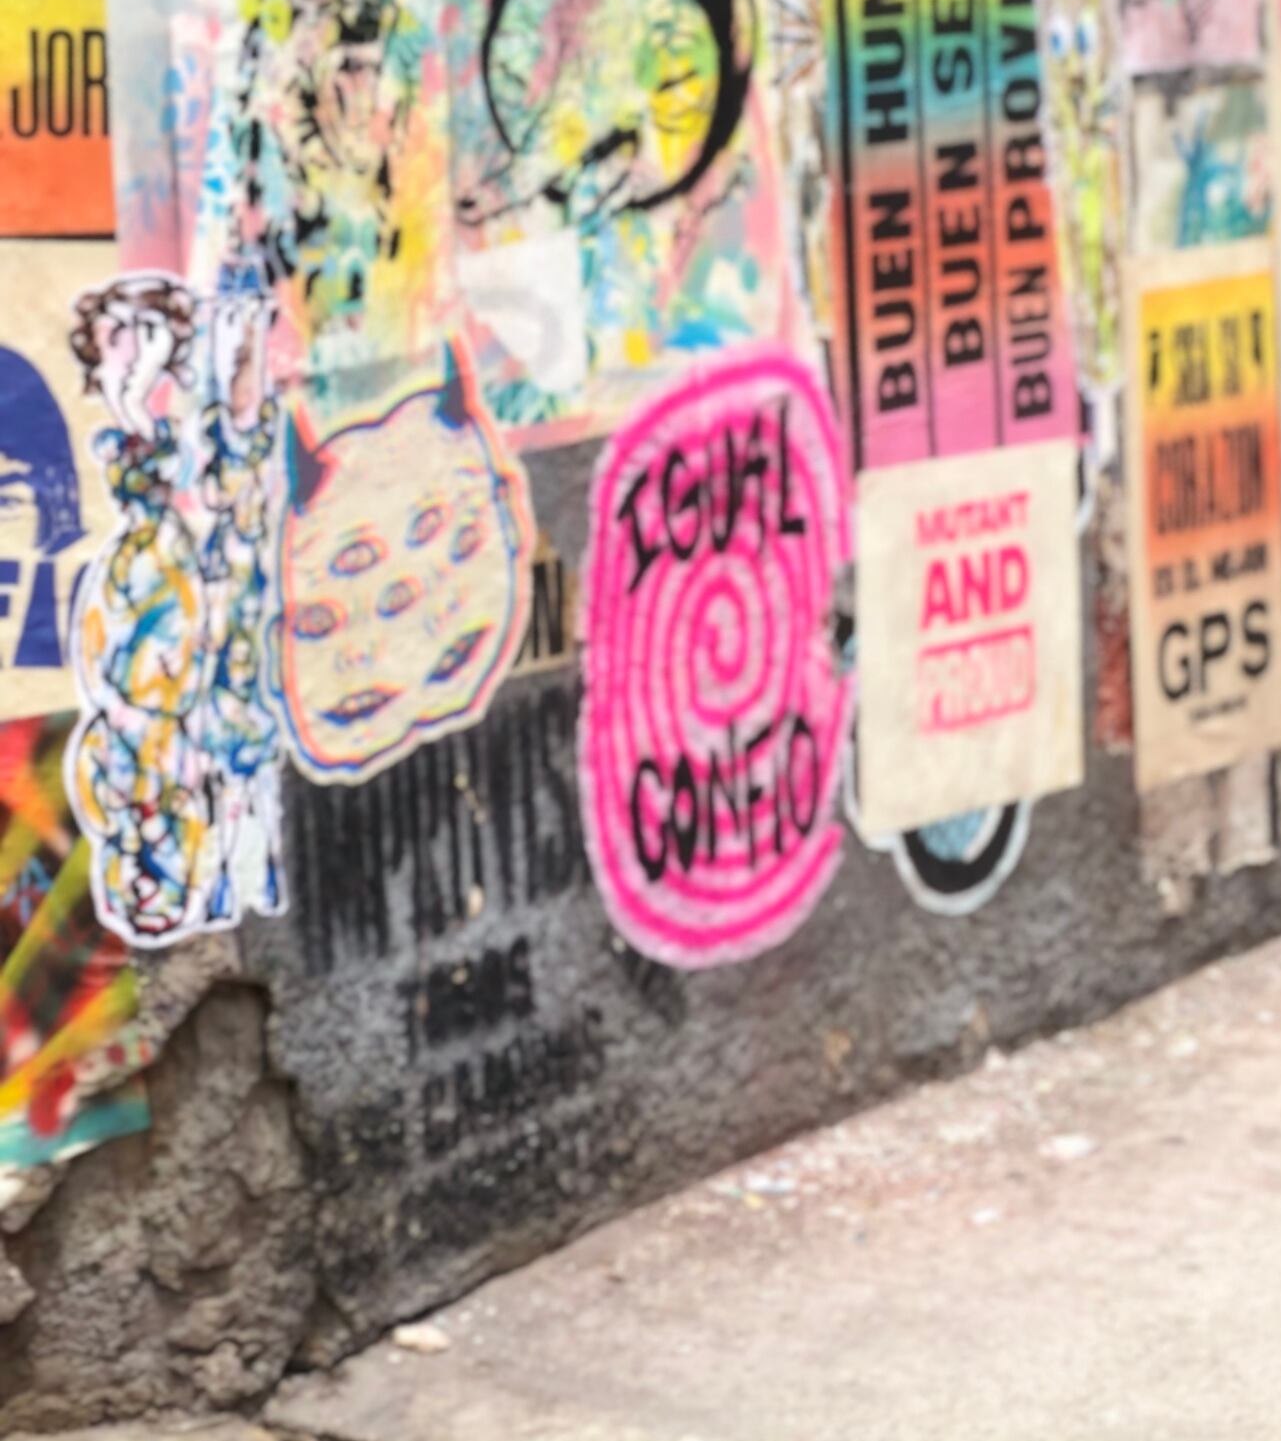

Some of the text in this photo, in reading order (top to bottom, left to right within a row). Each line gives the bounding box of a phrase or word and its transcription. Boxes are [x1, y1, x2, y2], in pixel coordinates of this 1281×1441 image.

[869, 188, 921, 413] BUEN
[936, 142, 985, 369] BUEN
[1007, 263, 1054, 422] BUEN
[617, 393, 806, 594] IGUAL
[915, 491, 1030, 548] MUTANT
[920, 545, 1030, 632] AND
[1158, 601, 1272, 702] GPS
